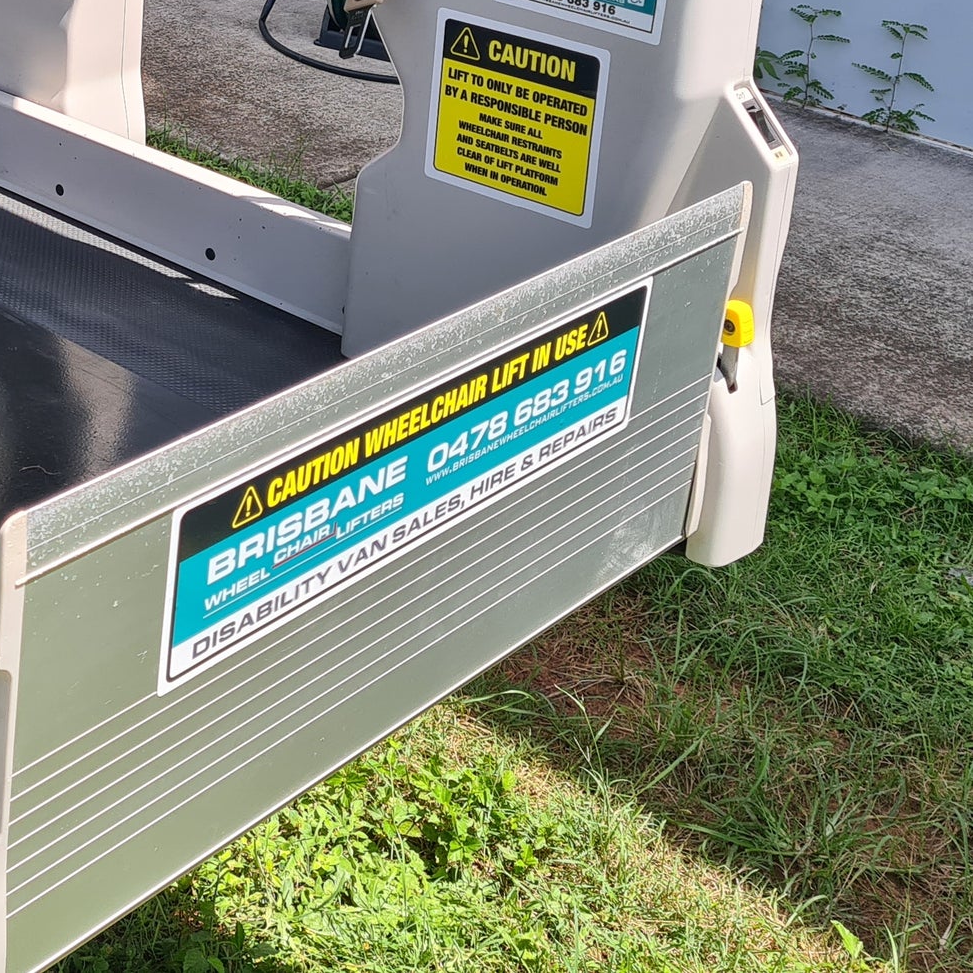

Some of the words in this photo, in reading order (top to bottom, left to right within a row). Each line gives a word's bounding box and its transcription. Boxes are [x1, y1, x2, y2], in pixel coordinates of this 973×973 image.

[593, 0, 615, 15] 916
[488, 40, 575, 82] CAUTION
[444, 84, 459, 98] BY
[460, 89, 467, 101] A
[470, 91, 541, 122] RESPONSIBLE
[544, 113, 587, 136] PERSON
[448, 67, 469, 82] LIFT
[471, 73, 484, 87] TO
[486, 78, 513, 95] ONLY
[515, 86, 529, 100] BE
[532, 91, 587, 116] OPERATED
[458, 120, 509, 143] WHEELCHAIR
[511, 136, 562, 159] RESTRAINTS
[479, 112, 502, 127] MAKE
[504, 120, 526, 134] SURE
[527, 127, 542, 139] ALL
[456, 133, 473, 145] AND
[475, 138, 518, 159] SEATBELTS
[520, 153, 537, 165] ARE
[538, 158, 561, 173] WELL
[457, 146, 482, 162] CLEAR
[484, 155, 495, 165] OF
[496, 158, 514, 171] LIFT
[514, 164, 558, 186] PLATFORM
[464, 162, 488, 177] WHEN
[489, 170, 498, 180] IN
[500, 174, 547, 196] OPERATION.
[267, 432, 368, 507] CAUTION
[365, 374, 488, 457] WHEELCHAIR
[491, 352, 530, 393] LIFT
[531, 342, 552, 373] IN
[554, 324, 588, 360] USE
[425, 373, 623, 486] WWW.BRISBANEWHEELCHAIRLIFTERS.COM.AU
[427, 410, 508, 472] 0478
[513, 378, 569, 426] 683
[573, 348, 627, 395] 916
[192, 566, 330, 659] DISABILITY
[330, 534, 387, 573] VAN
[391, 493, 465, 552] SALES,
[470, 462, 516, 500] HIRE
[520, 453, 533, 471] &
[538, 407, 617, 461] REPAIRS
[207, 455, 408, 585] BRISBANE
[204, 566, 270, 610] WHEEL
[270, 520, 332, 567] CHAIR
[335, 492, 404, 539] LIFTERS
